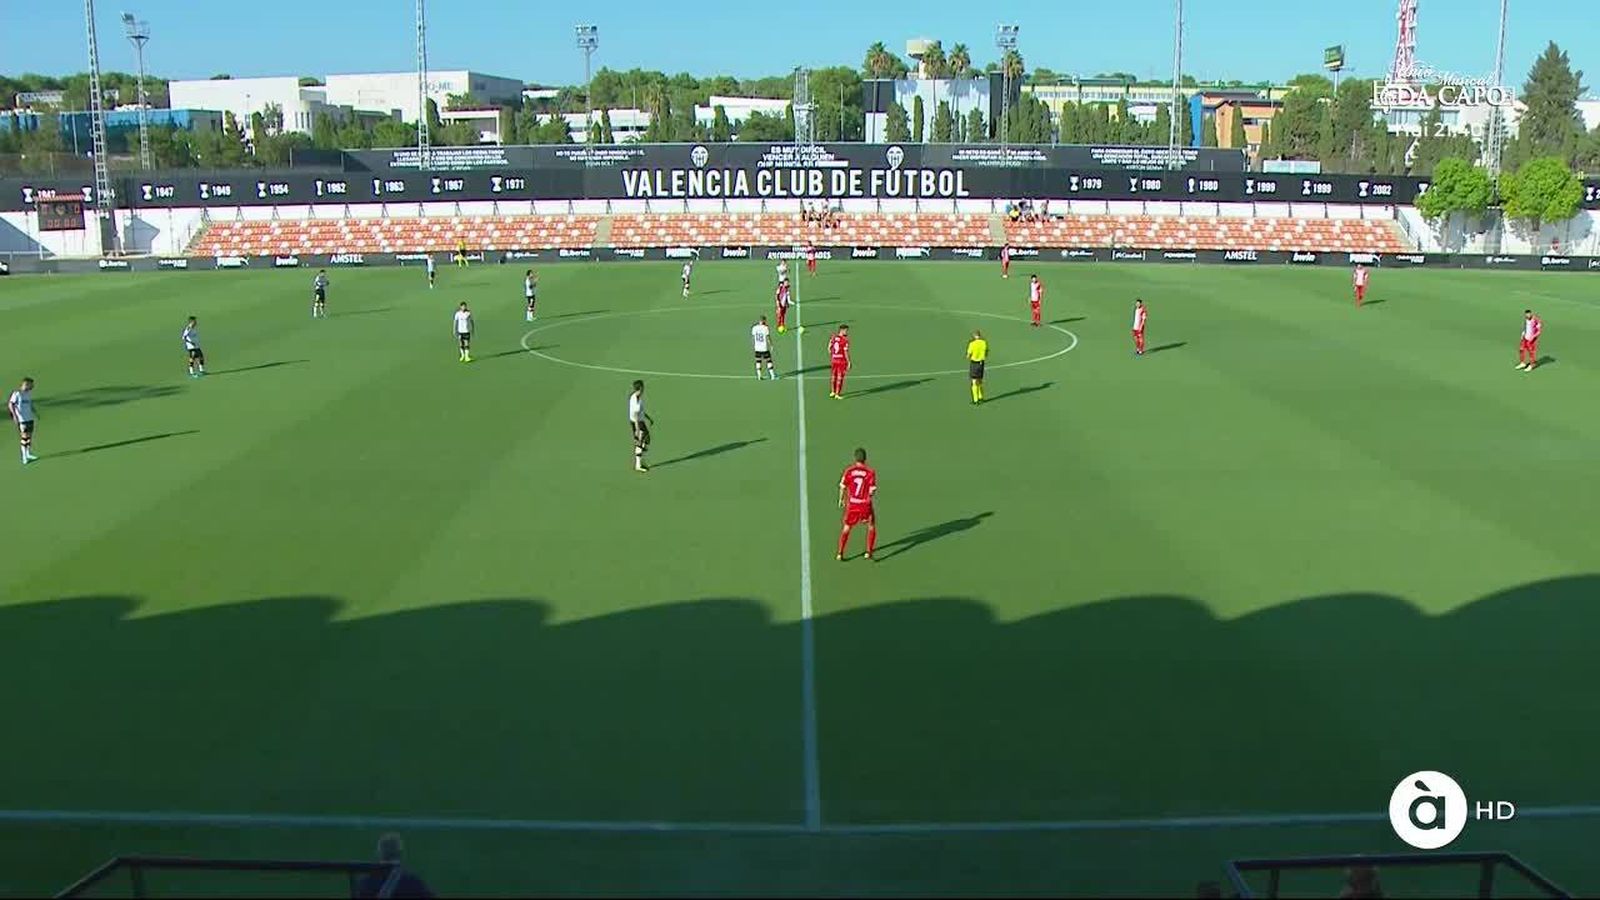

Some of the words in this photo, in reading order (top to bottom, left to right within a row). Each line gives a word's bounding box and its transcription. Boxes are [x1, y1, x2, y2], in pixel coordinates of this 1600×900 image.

[505, 178, 525, 190] 1971
[622, 169, 750, 197] VALENCIA
[757, 169, 823, 197] CLUB
[832, 169, 863, 197] DE
[871, 166, 969, 197] FÚTBOL
[1257, 181, 1276, 193] 1999
[155, 186, 174, 198] 1947
[269, 184, 289, 195] 1954
[723, 247, 747, 257] bwin
[853, 247, 877, 257] bwin
[1224, 251, 1257, 261] AMSTEL
[1293, 252, 1316, 262] bwin
[330, 254, 364, 264] AMSTEL
[853, 476, 863, 497] 7
